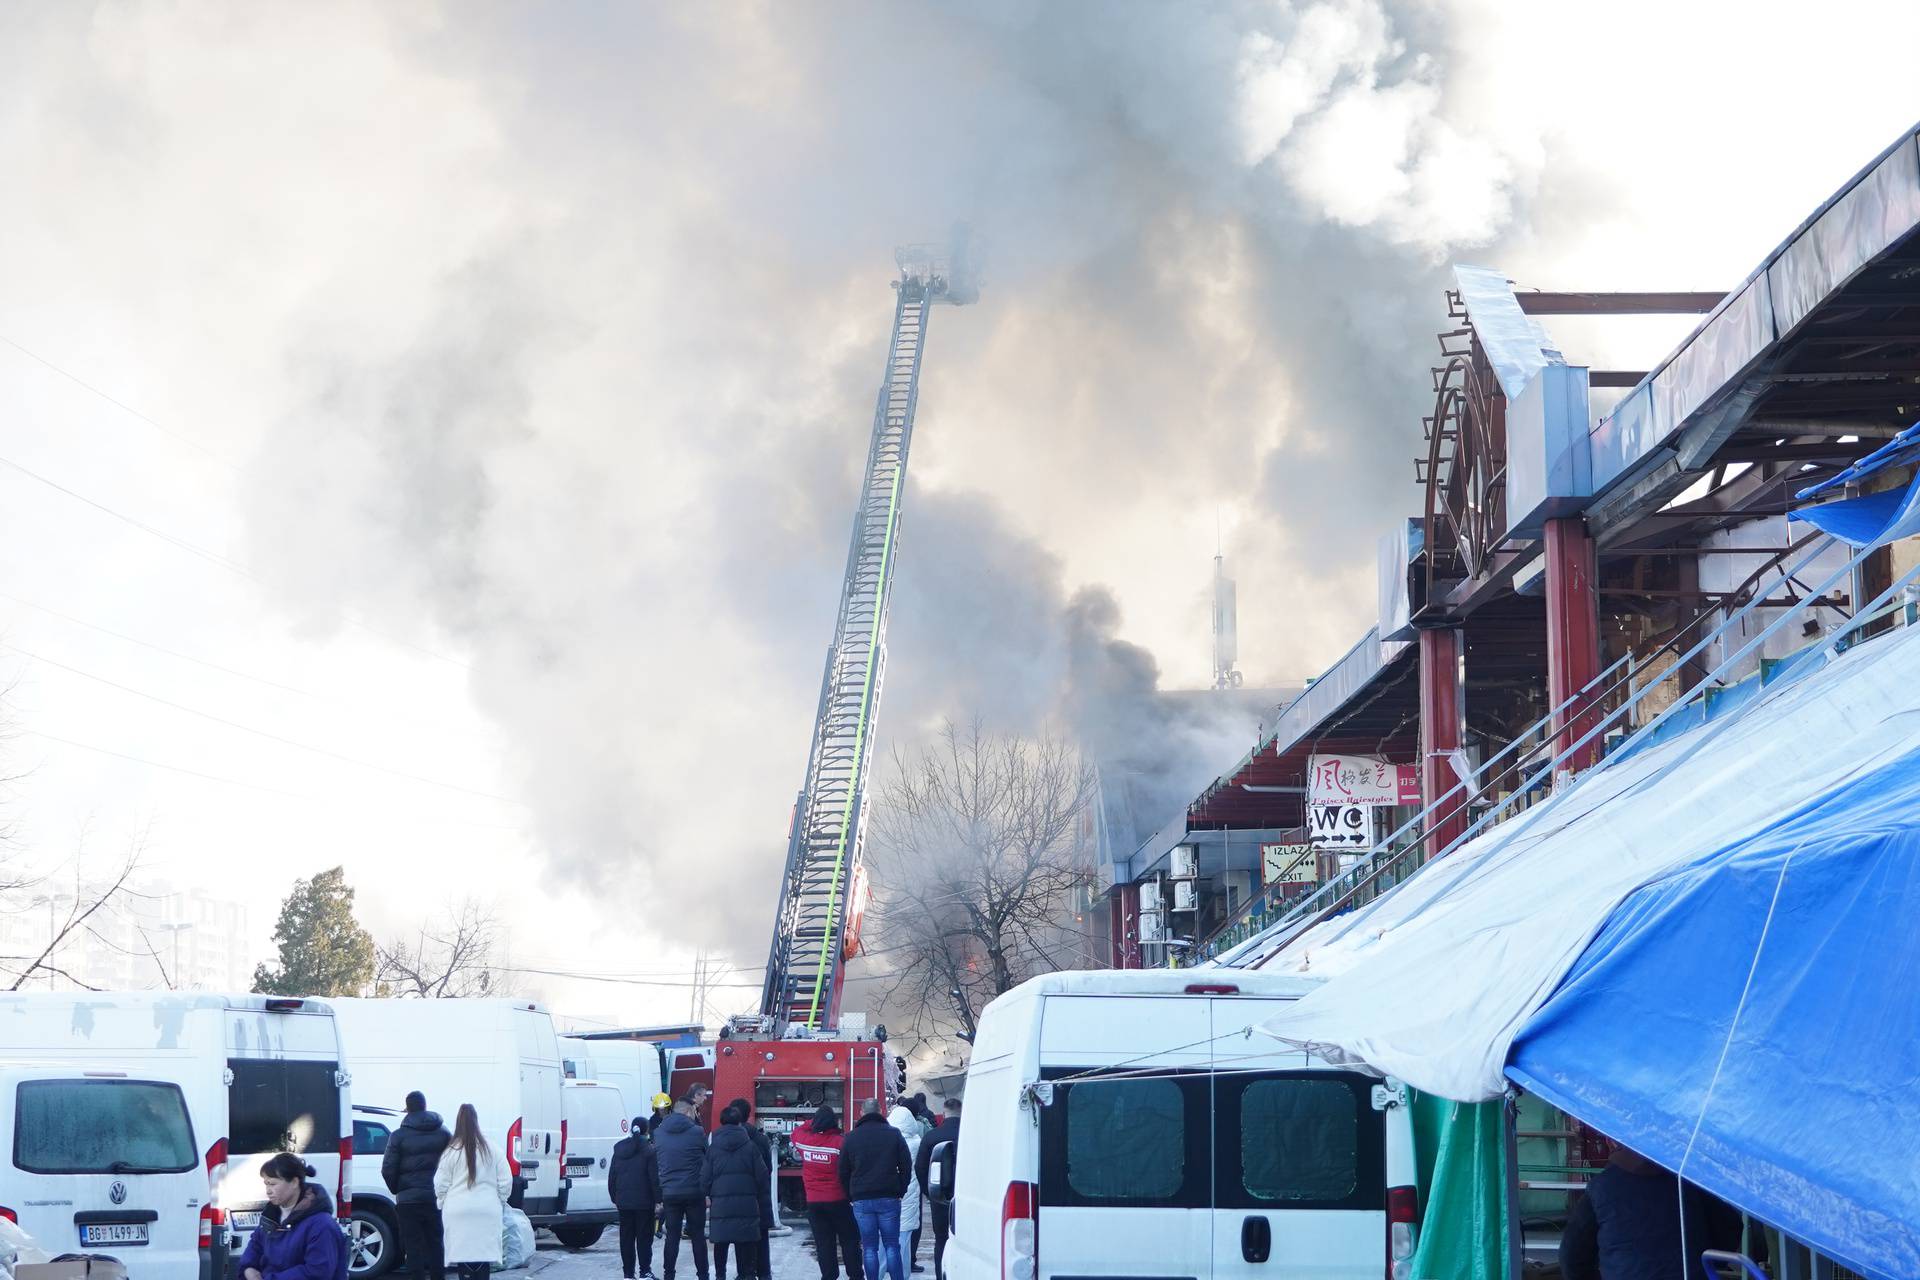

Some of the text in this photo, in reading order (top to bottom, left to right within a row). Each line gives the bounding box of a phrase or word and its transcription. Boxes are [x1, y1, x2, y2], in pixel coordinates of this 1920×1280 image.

[1314, 807, 1363, 830] WC
[1274, 846, 1304, 855] IZLAZ
[1281, 873, 1303, 881] EXIT
[812, 1153, 828, 1161] MAXI
[88, 1227, 101, 1241] BG
